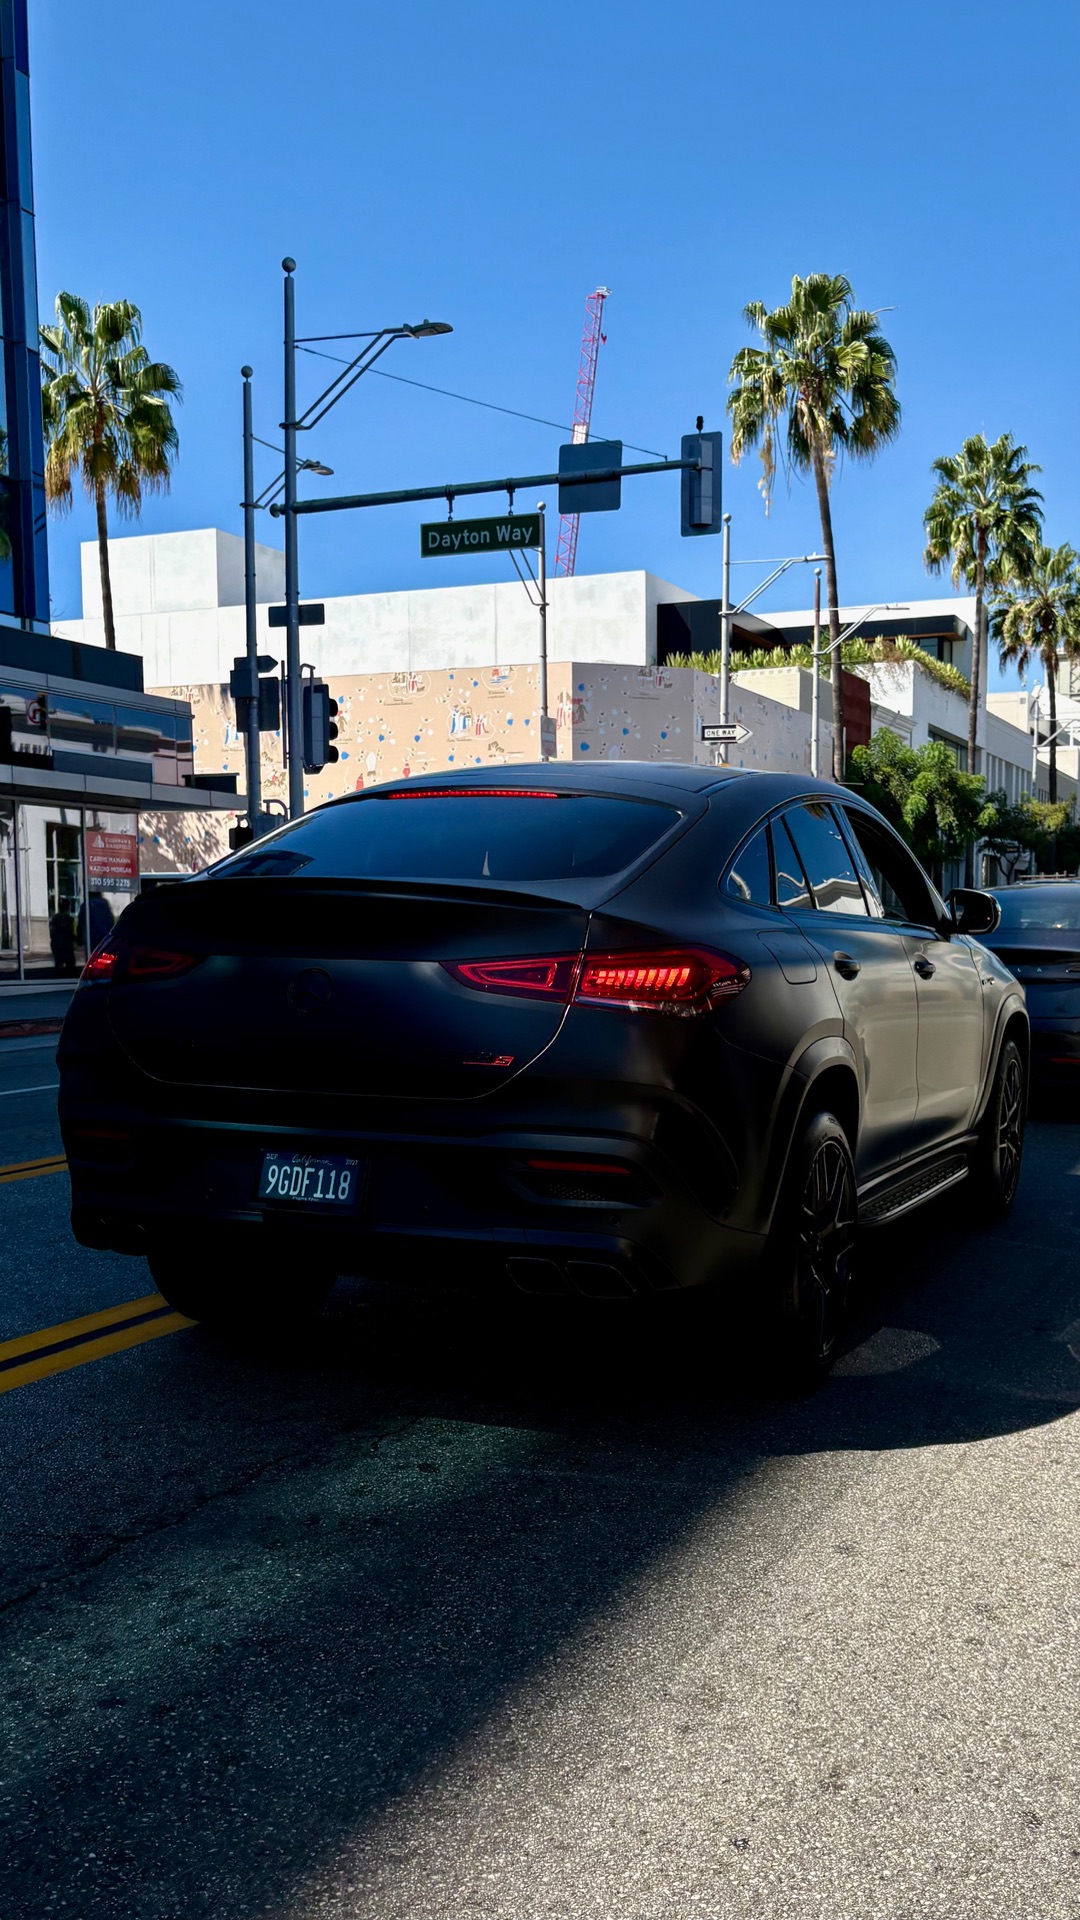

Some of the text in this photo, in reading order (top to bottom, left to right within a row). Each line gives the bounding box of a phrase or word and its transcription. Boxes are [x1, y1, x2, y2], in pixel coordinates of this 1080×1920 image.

[428, 525, 533, 550] Dayton Way
[91, 877, 102, 886] 310
[103, 878, 115, 887] 595
[291, 1153, 333, 1167] California
[265, 1164, 351, 1200] 9GDF118
